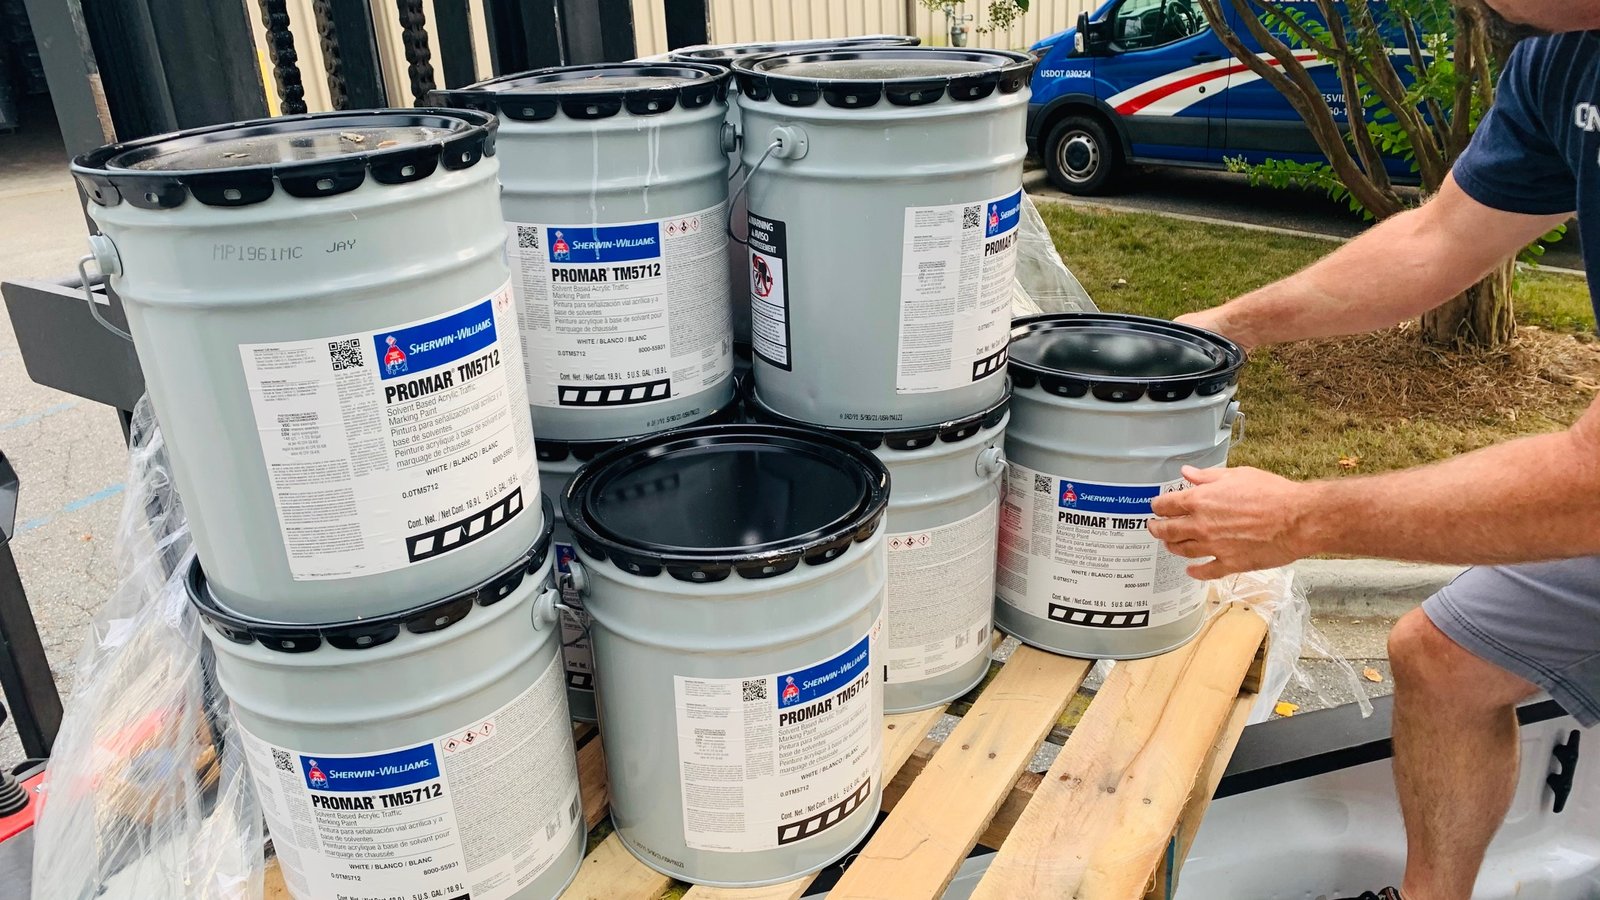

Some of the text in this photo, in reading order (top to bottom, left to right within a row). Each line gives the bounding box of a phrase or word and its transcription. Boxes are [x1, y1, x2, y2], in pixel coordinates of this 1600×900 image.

[1040, 69, 1091, 79] USDOT 030254
[325, 239, 356, 253] JAY
[612, 263, 661, 281] TM5712
[552, 284, 573, 292] Solvent
[574, 284, 591, 292] Based
[591, 284, 611, 293] Acrylic
[552, 292, 575, 300] Marking
[599, 337, 624, 345] BLANCO
[627, 334, 647, 342] BLANC
[457, 349, 501, 383] TM5712
[386, 383, 476, 417] Solvent Based Acrylic Traffic
[388, 407, 438, 426] Marking Paint
[390, 425, 417, 437] Pintura
[418, 420, 434, 432] para
[434, 407, 471, 424] señalización
[392, 424, 453, 447] base de solventes
[394, 444, 425, 458] Peinture
[425, 434, 455, 451] acrylique
[460, 428, 474, 438] base
[475, 422, 482, 432] de
[396, 438, 471, 469] marquage de chaussée
[425, 440, 499, 476] WHITE BLANCO BLANC
[401, 483, 439, 499] 0.0TM5712
[1079, 492, 1153, 504] SHERWIN-WILLIAM
[407, 519, 424, 530] Cont.
[424, 515, 437, 526] Net.
[440, 508, 452, 519] Net
[451, 504, 465, 515] Cont.
[465, 497, 478, 509] 18.9
[1111, 517, 1154, 530] TM571
[1091, 529, 1108, 537] Acrylic
[836, 672, 869, 706] TM5712
[778, 725, 800, 736] Solvent
[800, 720, 818, 732] Based
[778, 727, 817, 743] Marking Paint
[778, 749, 793, 758] base
[800, 758, 843, 780] WHITE BLANCO
[380, 783, 443, 808] TM5712
[314, 810, 336, 819] Solvent
[358, 812, 380, 820] Acrylic
[381, 809, 403, 818] Traffic
[316, 817, 340, 826] Marking
[340, 828, 355, 836] para
[355, 826, 394, 835] señalización
[395, 823, 408, 831] vial
[320, 833, 334, 841] base
[334, 834, 343, 842] de
[347, 842, 376, 851] acrylique
[383, 841, 399, 849] base
[400, 840, 409, 848] de
[409, 835, 434, 846] solvant
[435, 830, 450, 840] pour
[355, 850, 363, 858] de
[375, 862, 404, 870] BLANCO
[409, 856, 433, 867] BLANC
[423, 861, 459, 876] 8000-55931
[430, 889, 443, 899] GAL
[446, 884, 460, 893] 18.9
